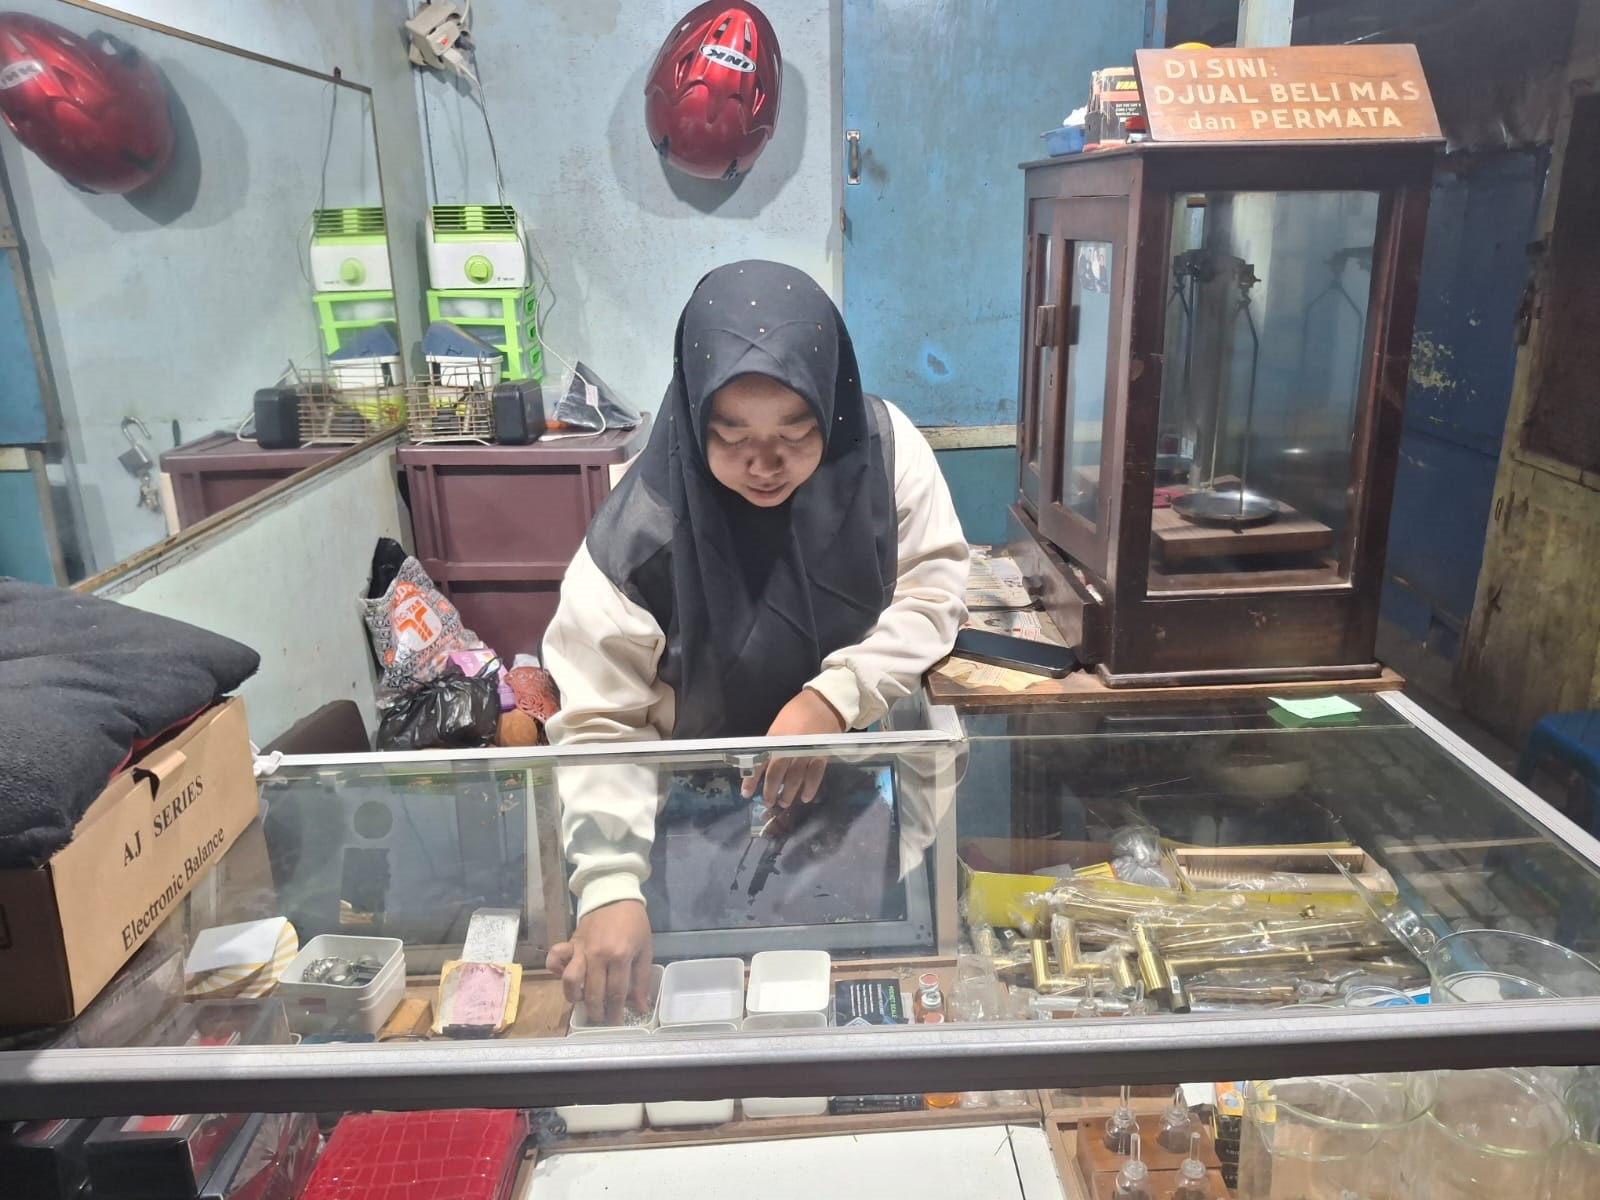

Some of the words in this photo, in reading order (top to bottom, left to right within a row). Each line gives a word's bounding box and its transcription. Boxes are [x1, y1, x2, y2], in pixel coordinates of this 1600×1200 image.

[706, 49, 750, 69] INK
[1165, 59, 1198, 79] DI
[1154, 85, 1259, 105] DJUAL
[1270, 82, 1340, 103] BELI
[1351, 80, 1420, 101] MAS
[1188, 110, 1235, 130] dan
[1251, 107, 1402, 129] PERMATA
[123, 830, 143, 867] AJ
[153, 775, 204, 838] SERIES
[121, 872, 184, 952] Electronic
[184, 827, 225, 882] Balance
